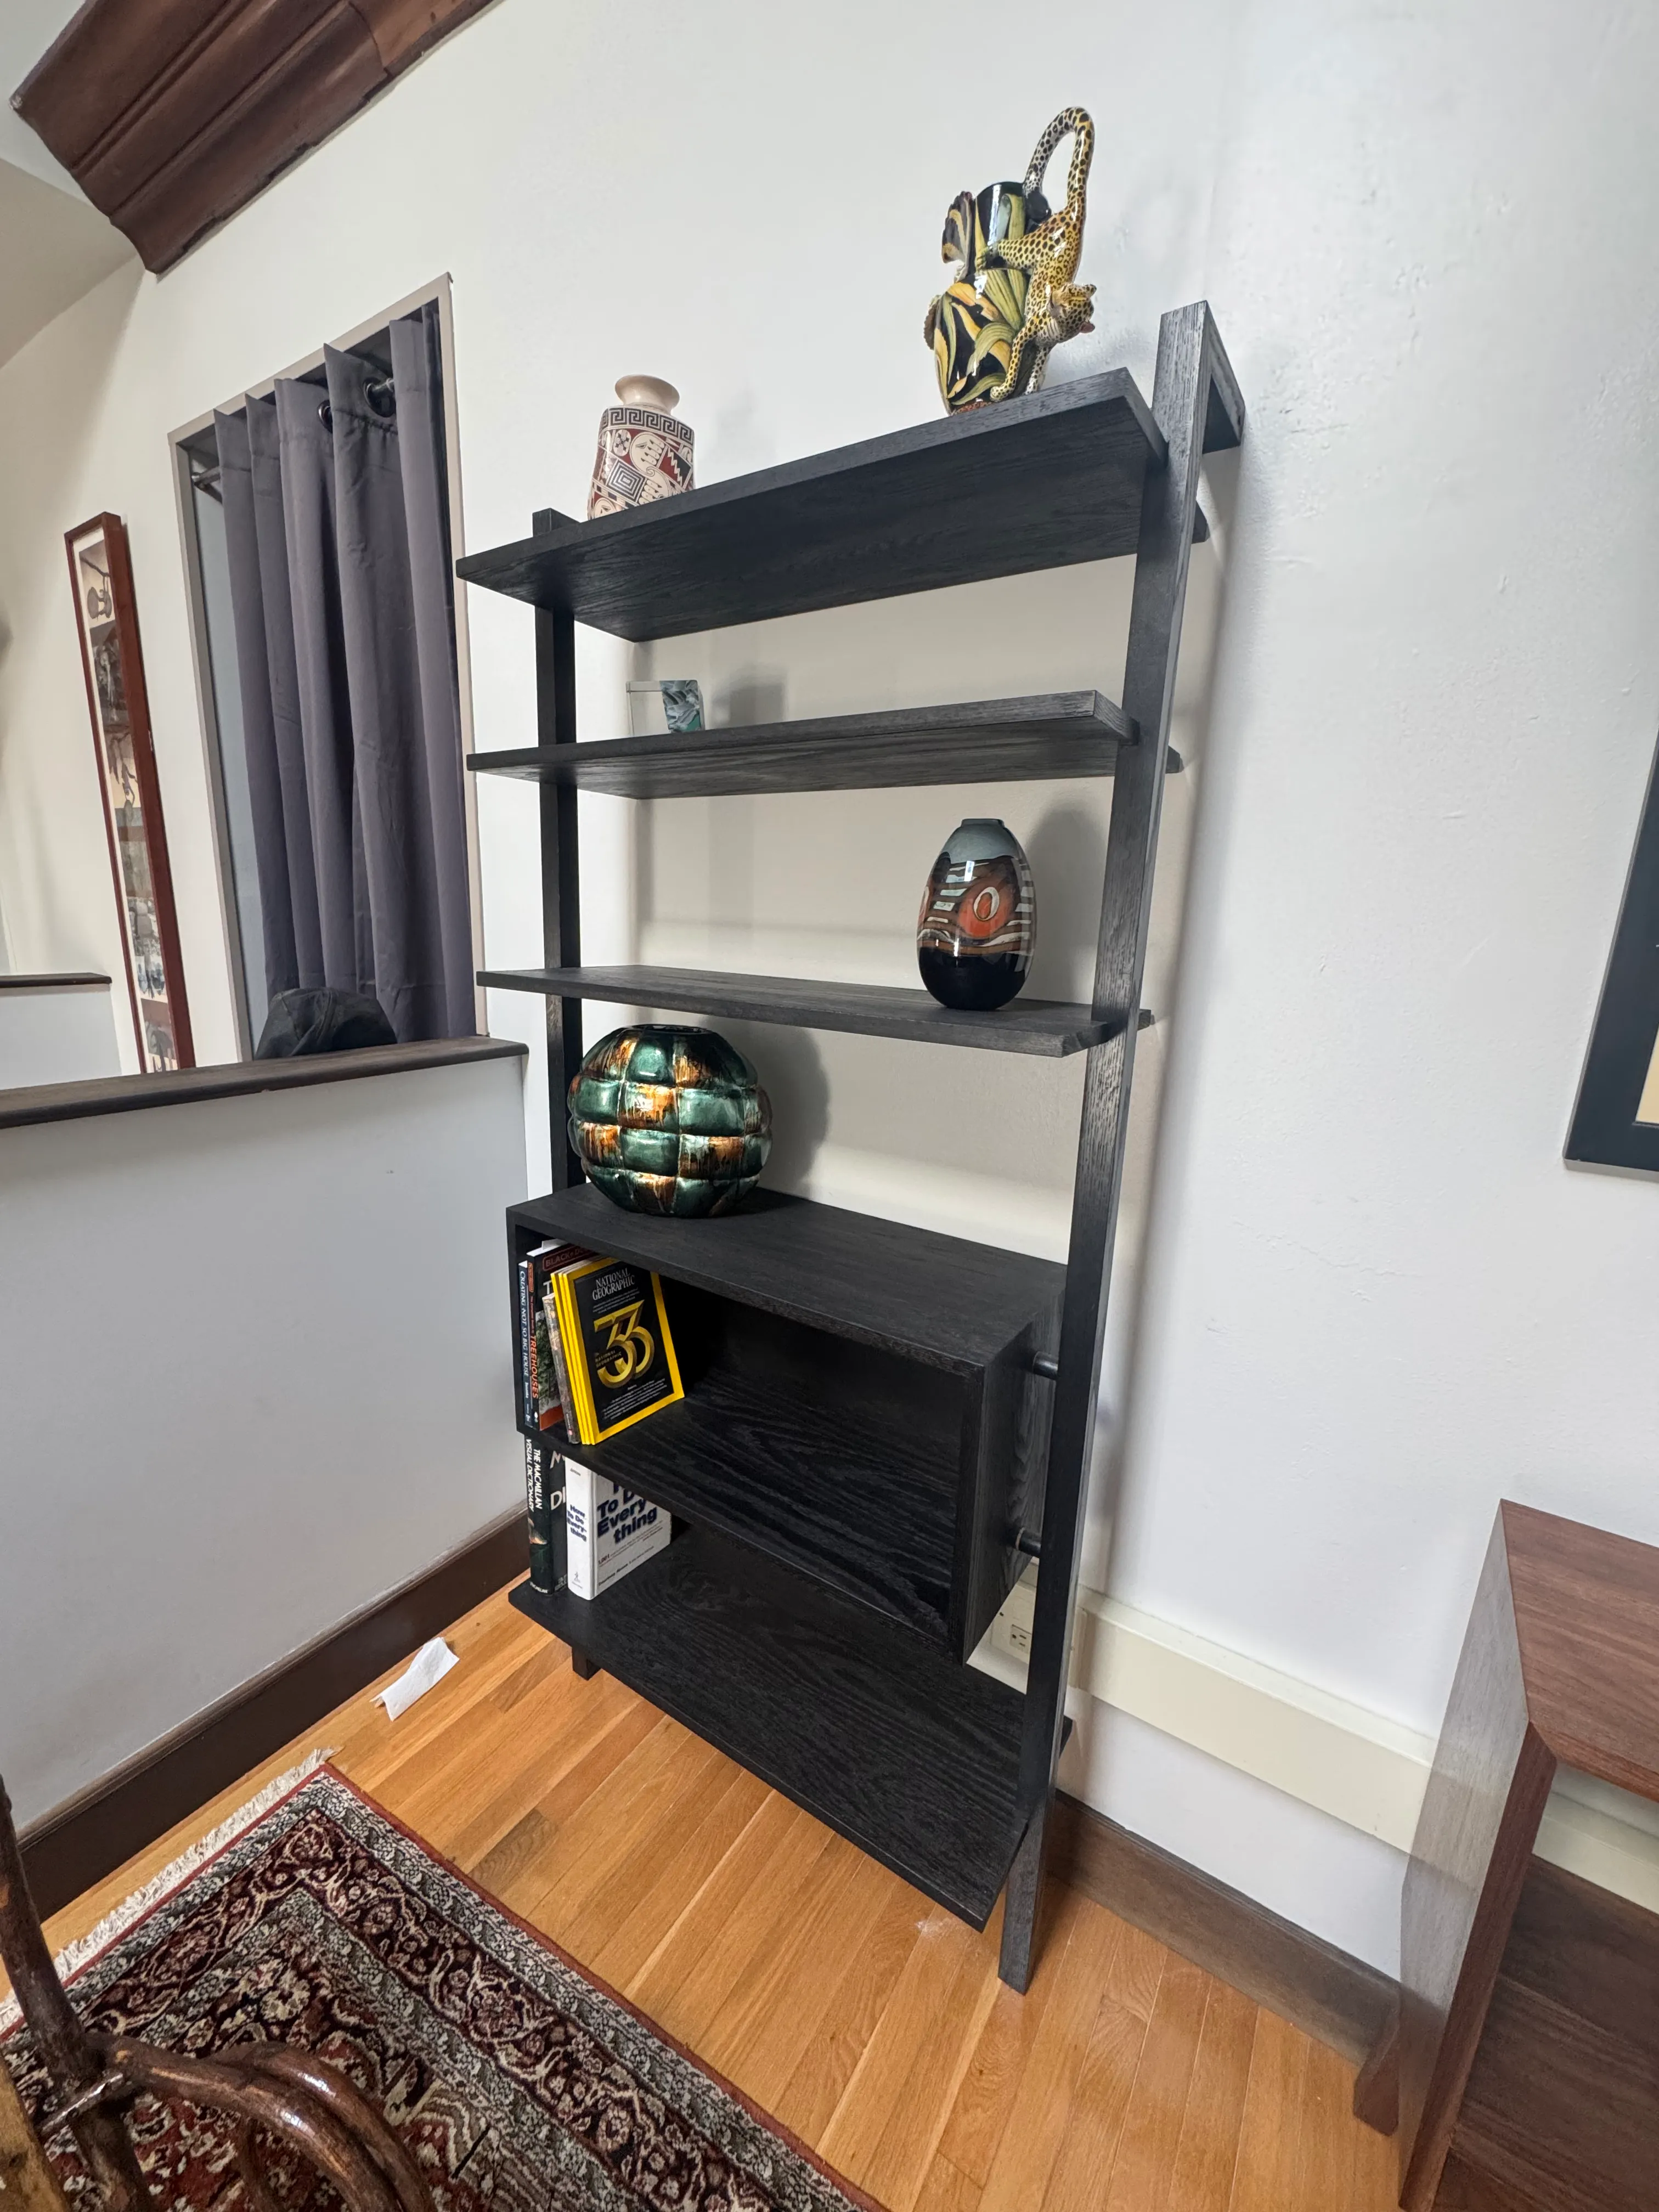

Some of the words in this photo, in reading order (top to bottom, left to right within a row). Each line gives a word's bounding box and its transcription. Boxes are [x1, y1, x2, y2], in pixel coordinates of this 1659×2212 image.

[592, 1274, 635, 1301] GEOGRAPHIC
[596, 1267, 630, 1289] NATIONAL
[522, 1327, 528, 1337] SO
[531, 1335, 539, 1398] TREEHOUSES
[534, 1462, 543, 1509] MACMILLAN
[570, 1504, 585, 1518] How
[575, 1515, 584, 1525] Do
[597, 1499, 619, 1519] To
[597, 1499, 646, 1538] Every
[570, 1527, 587, 1542] thing
[613, 1506, 657, 1544] thing
